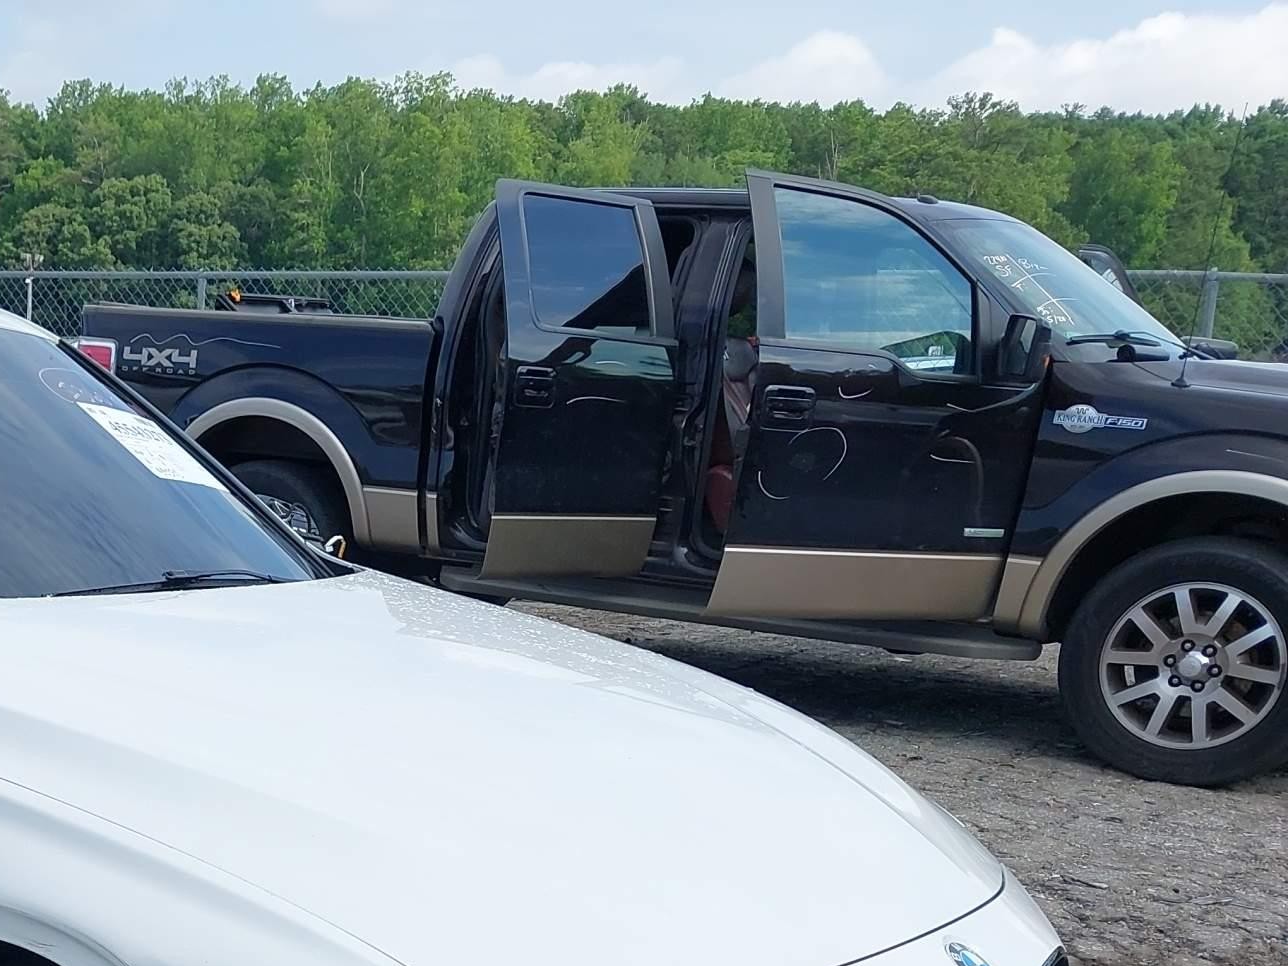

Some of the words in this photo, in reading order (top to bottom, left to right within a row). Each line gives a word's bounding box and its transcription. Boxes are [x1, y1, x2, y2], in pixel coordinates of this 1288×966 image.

[121, 365, 150, 373] OFF
[155, 367, 197, 375] ROAD
[1057, 412, 1076, 423] KING
[1077, 415, 1103, 425] RANCH
